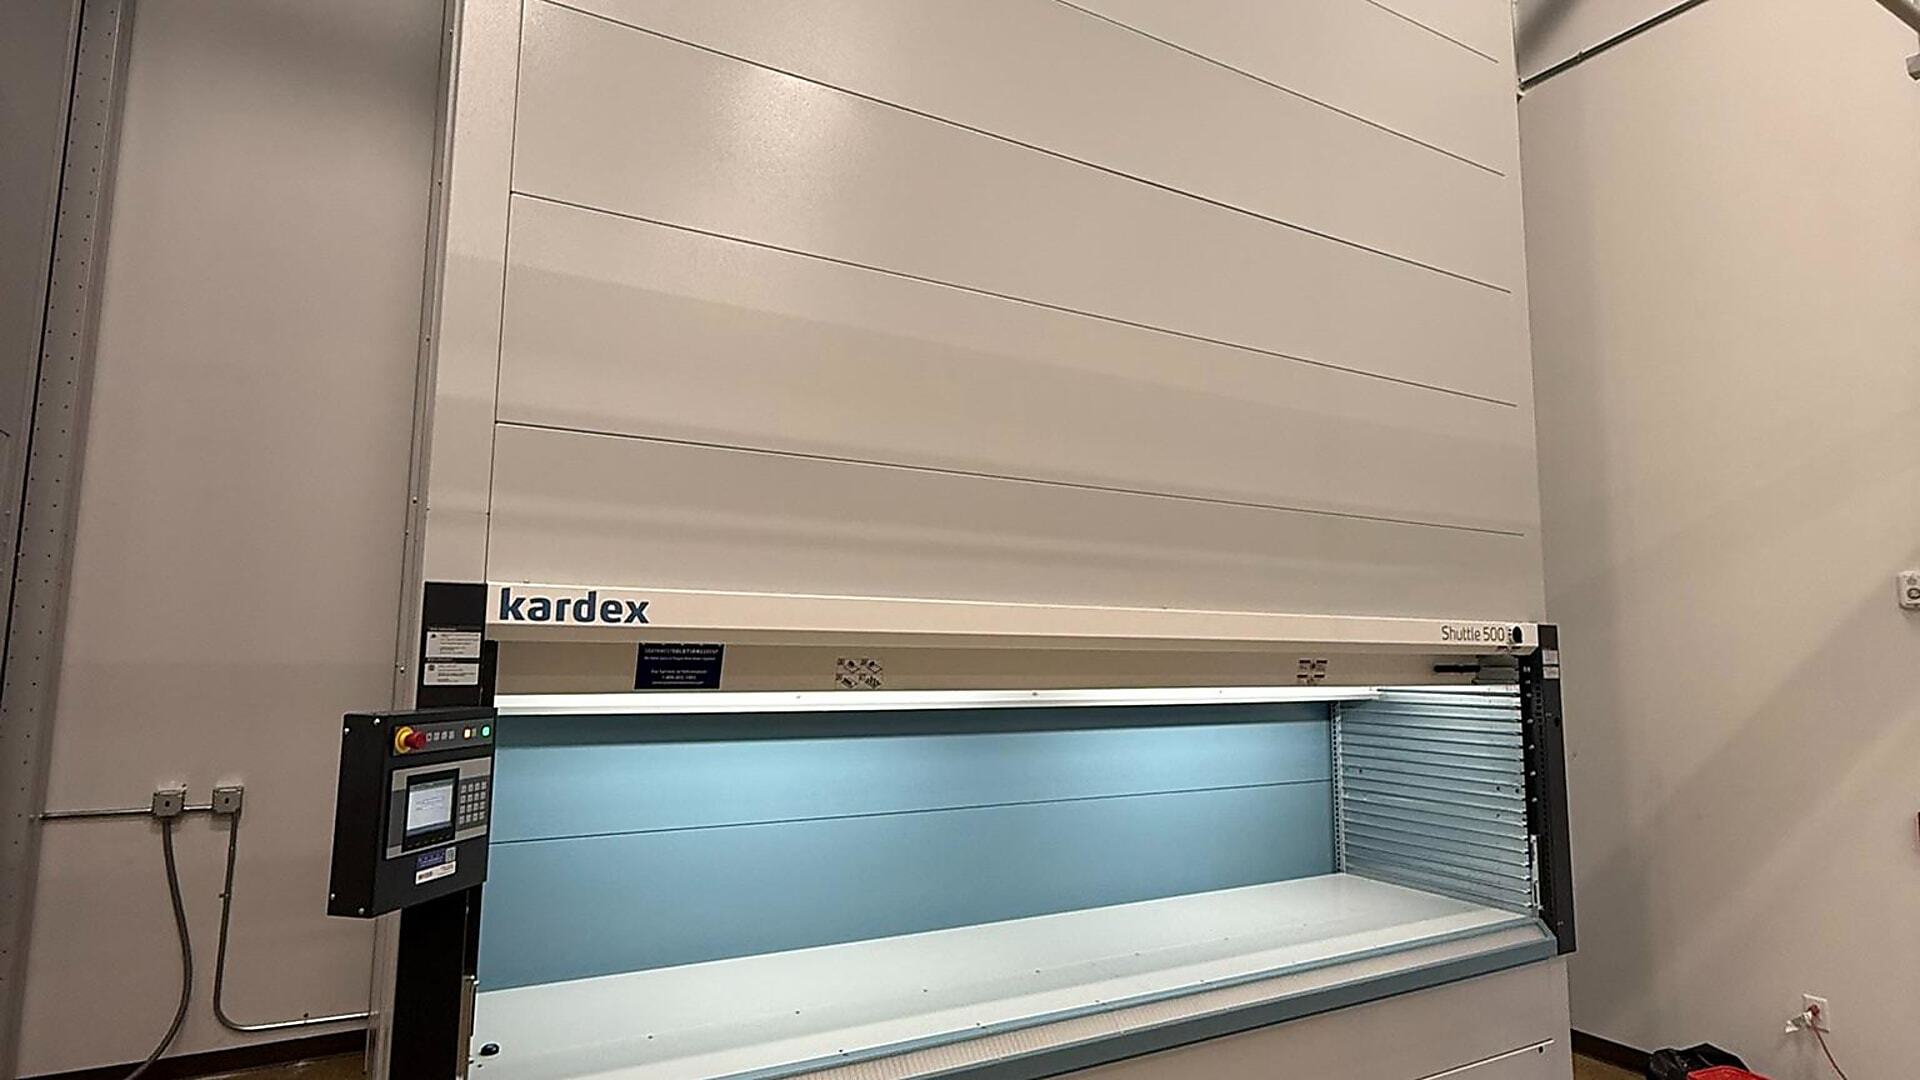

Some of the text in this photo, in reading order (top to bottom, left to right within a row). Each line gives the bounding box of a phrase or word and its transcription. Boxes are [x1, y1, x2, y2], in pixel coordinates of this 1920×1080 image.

[499, 587, 649, 624] kardex
[1441, 625, 1505, 642] Shuttle 500
